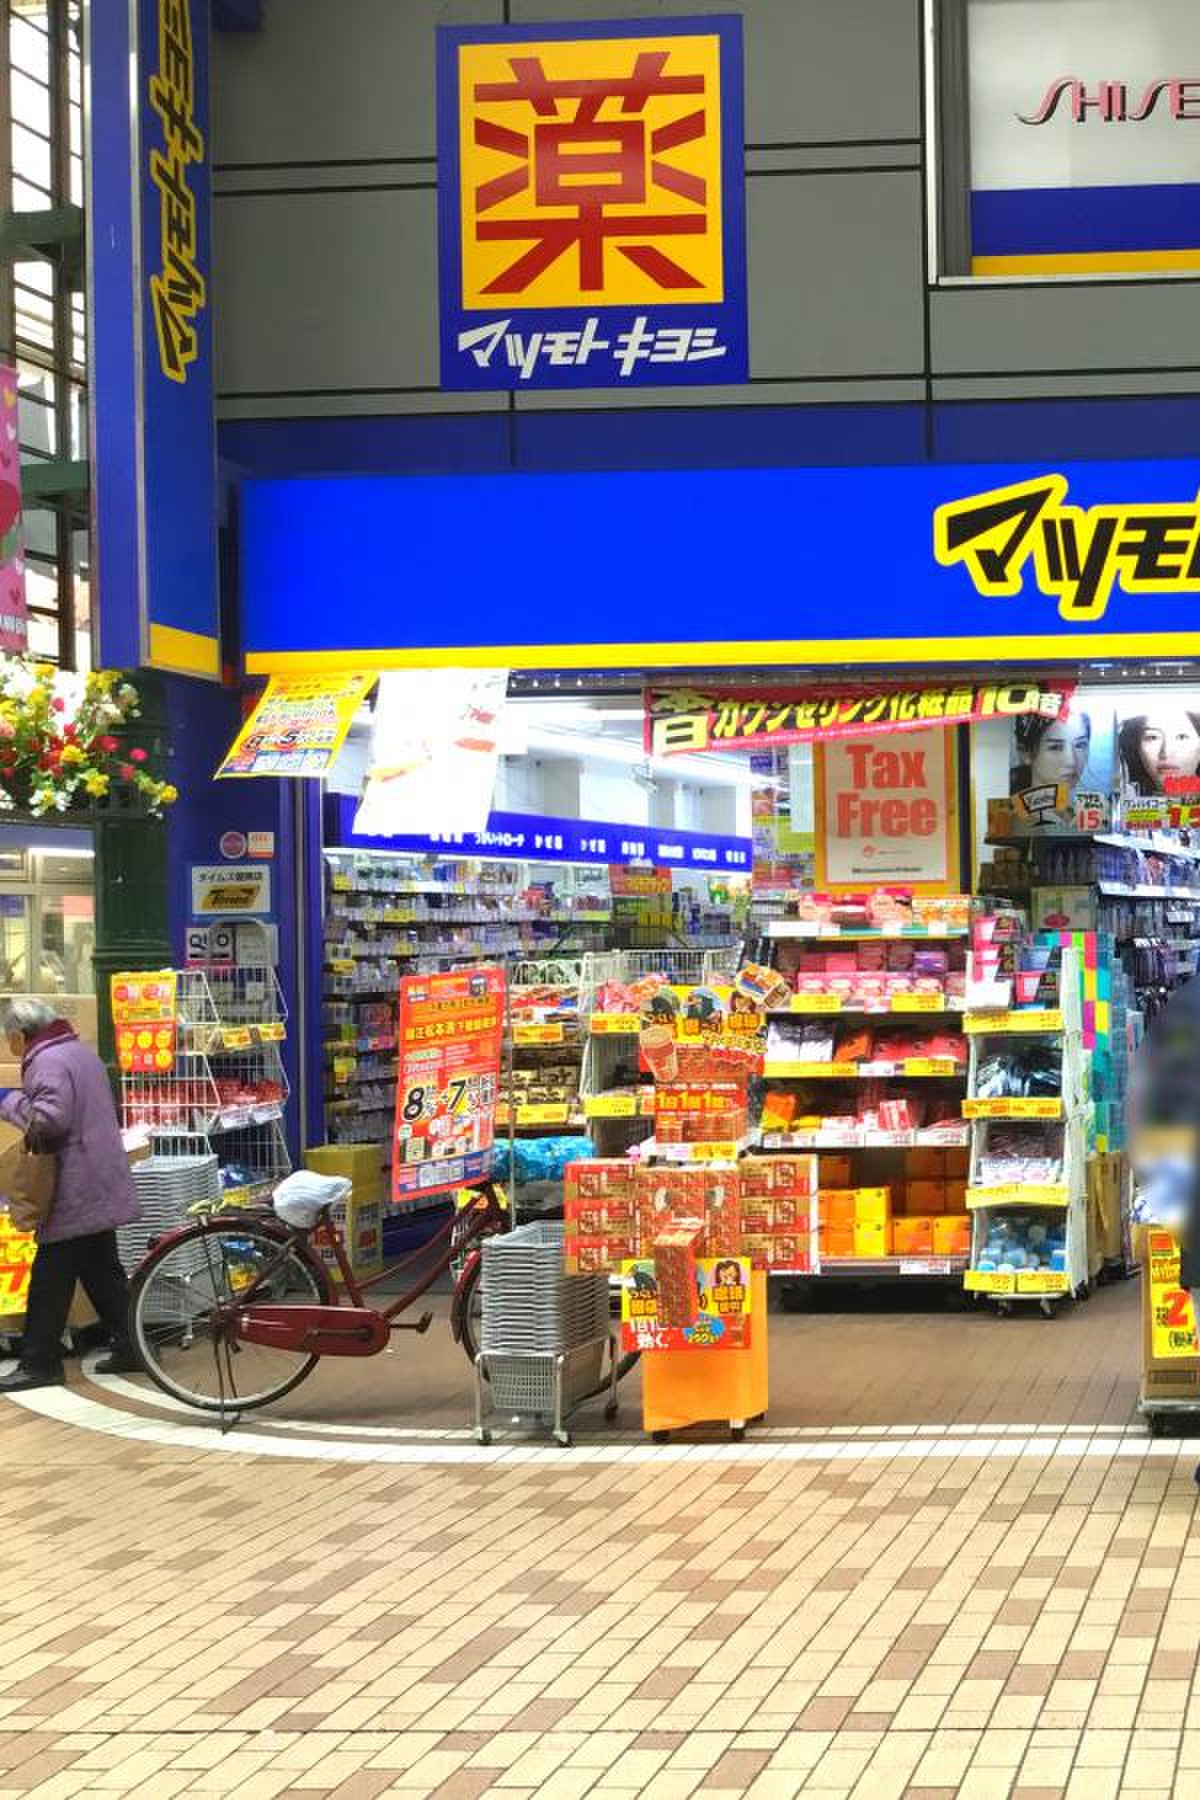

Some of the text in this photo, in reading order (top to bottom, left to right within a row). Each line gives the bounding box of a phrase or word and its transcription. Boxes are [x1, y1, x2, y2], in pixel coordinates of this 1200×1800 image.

[474, 52, 707, 295] 薬
[845, 744, 927, 789] Tax
[837, 793, 937, 839] Free
